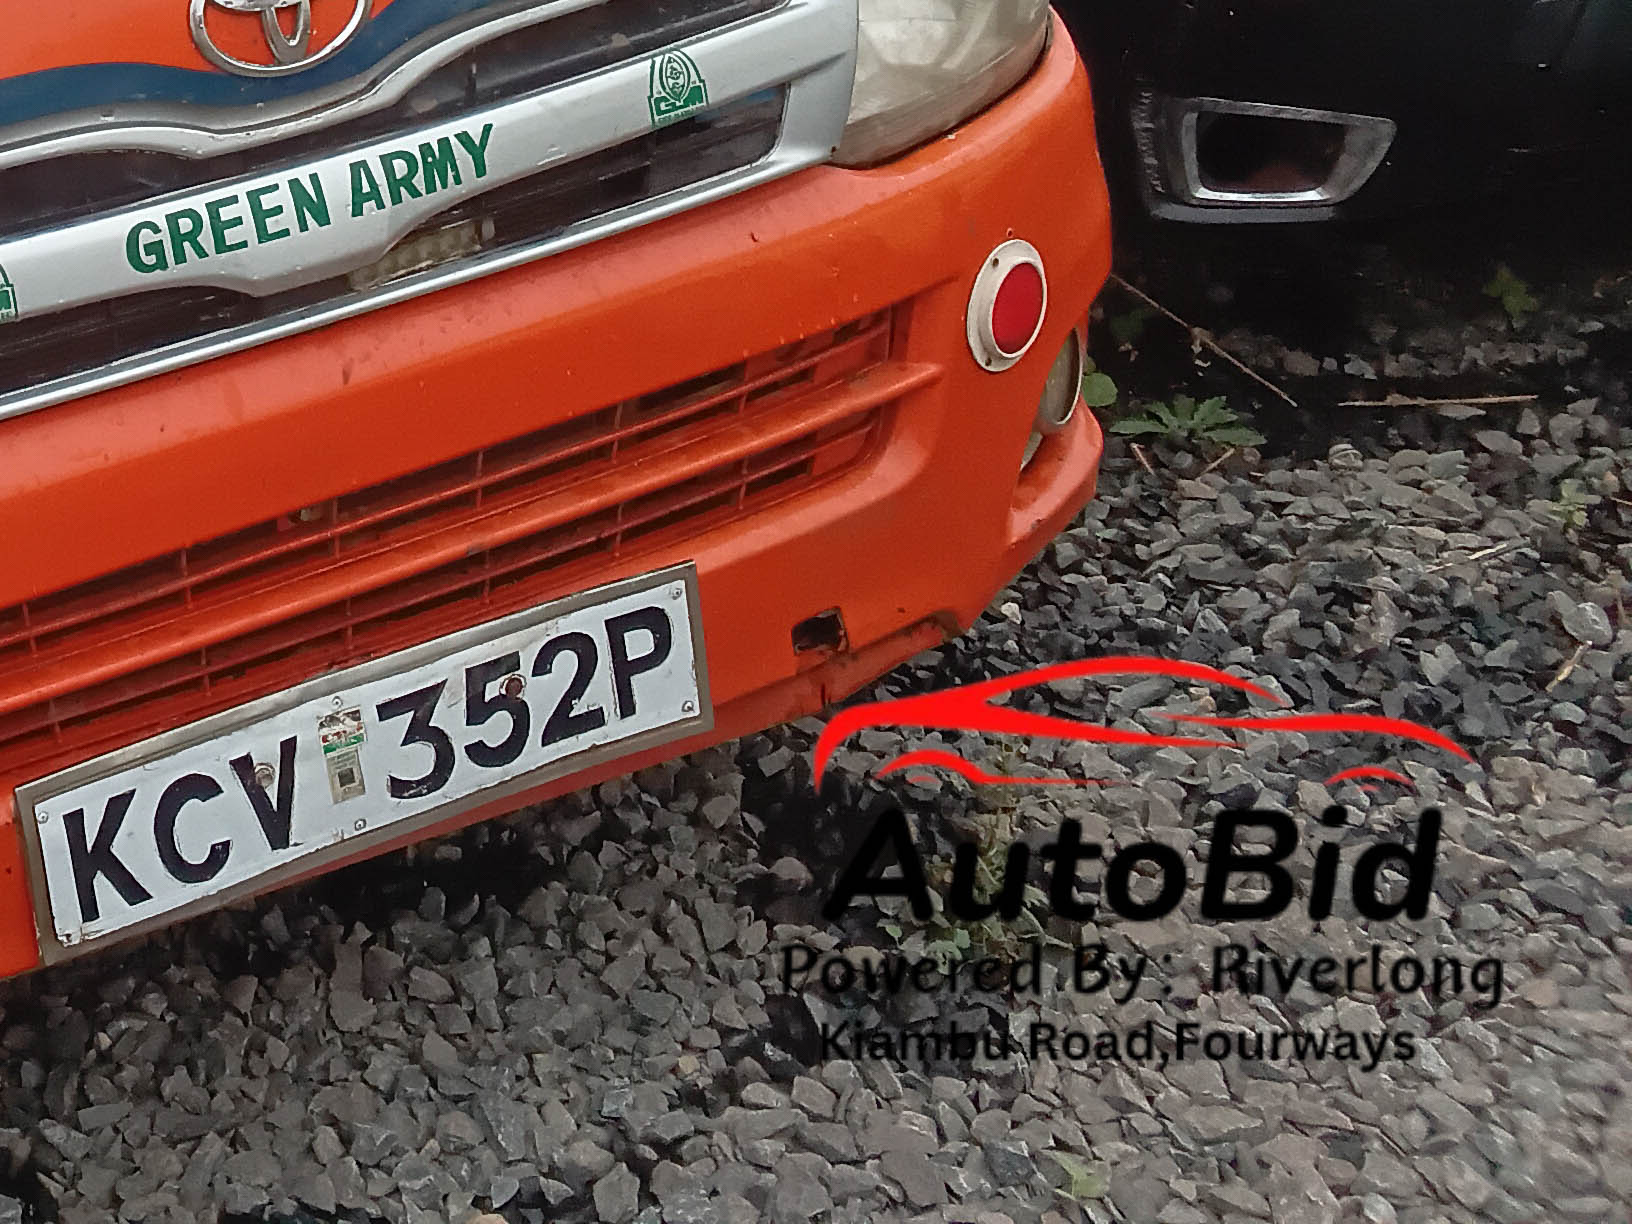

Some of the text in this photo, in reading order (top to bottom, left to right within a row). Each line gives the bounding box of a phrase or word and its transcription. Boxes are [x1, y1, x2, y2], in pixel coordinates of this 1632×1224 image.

[125, 123, 496, 274] GREEN ARMY
[62, 605, 673, 922] KCV 352P
